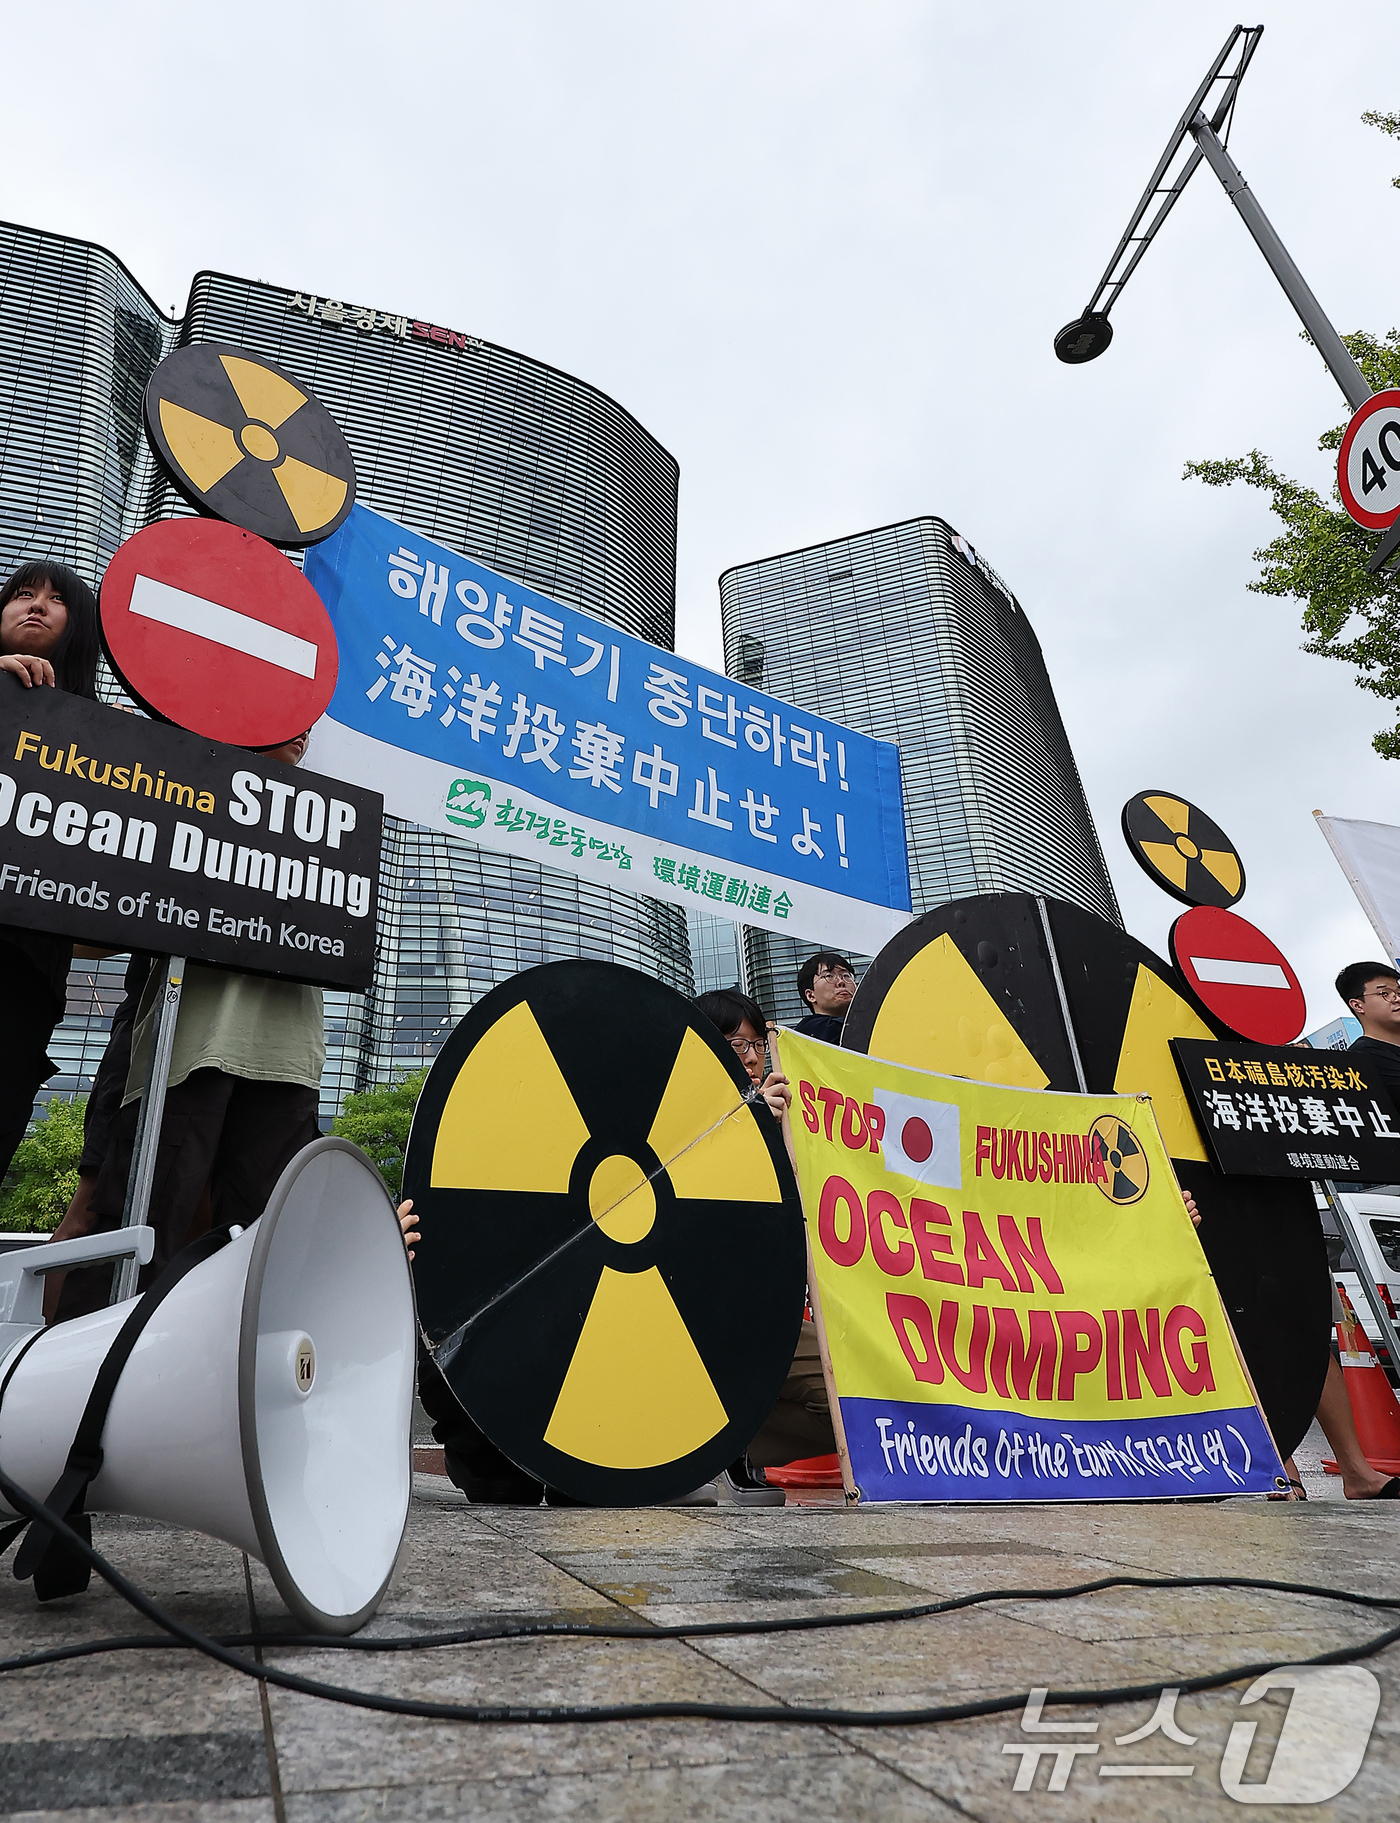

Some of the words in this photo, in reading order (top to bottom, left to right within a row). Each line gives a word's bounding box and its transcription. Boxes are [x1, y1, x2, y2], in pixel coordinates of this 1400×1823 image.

[286, 293, 408, 338] 서울경제
[1361, 420, 1400, 496] 40
[387, 545, 622, 701] 해양투기
[644, 661, 850, 792] 중단하라!
[14, 730, 216, 815] Fukushima
[228, 770, 357, 849] STOP
[365, 633, 850, 869] 海洋投棄中止せよ!
[169, 821, 371, 918] Dumping
[494, 798, 633, 870] 환경운동연합
[653, 856, 795, 919] 環境運動連合
[0, 863, 110, 911] Friends
[117, 892, 151, 918] of
[155, 897, 200, 929] the
[207, 908, 272, 944] Earth
[279, 923, 345, 957] Korea
[799, 1080, 886, 1154] STOP
[975, 1125, 1109, 1184] FUKUSHIMA
[1203, 1089, 1400, 1138] 海洋投棄中止
[1286, 1152, 1361, 1171] 環境運動連合
[818, 1175, 1065, 1295] OCEAN
[886, 1292, 1216, 1401] DUMPING
[874, 1418, 989, 1478] Friends
[1027, 1431, 1069, 1480] the
